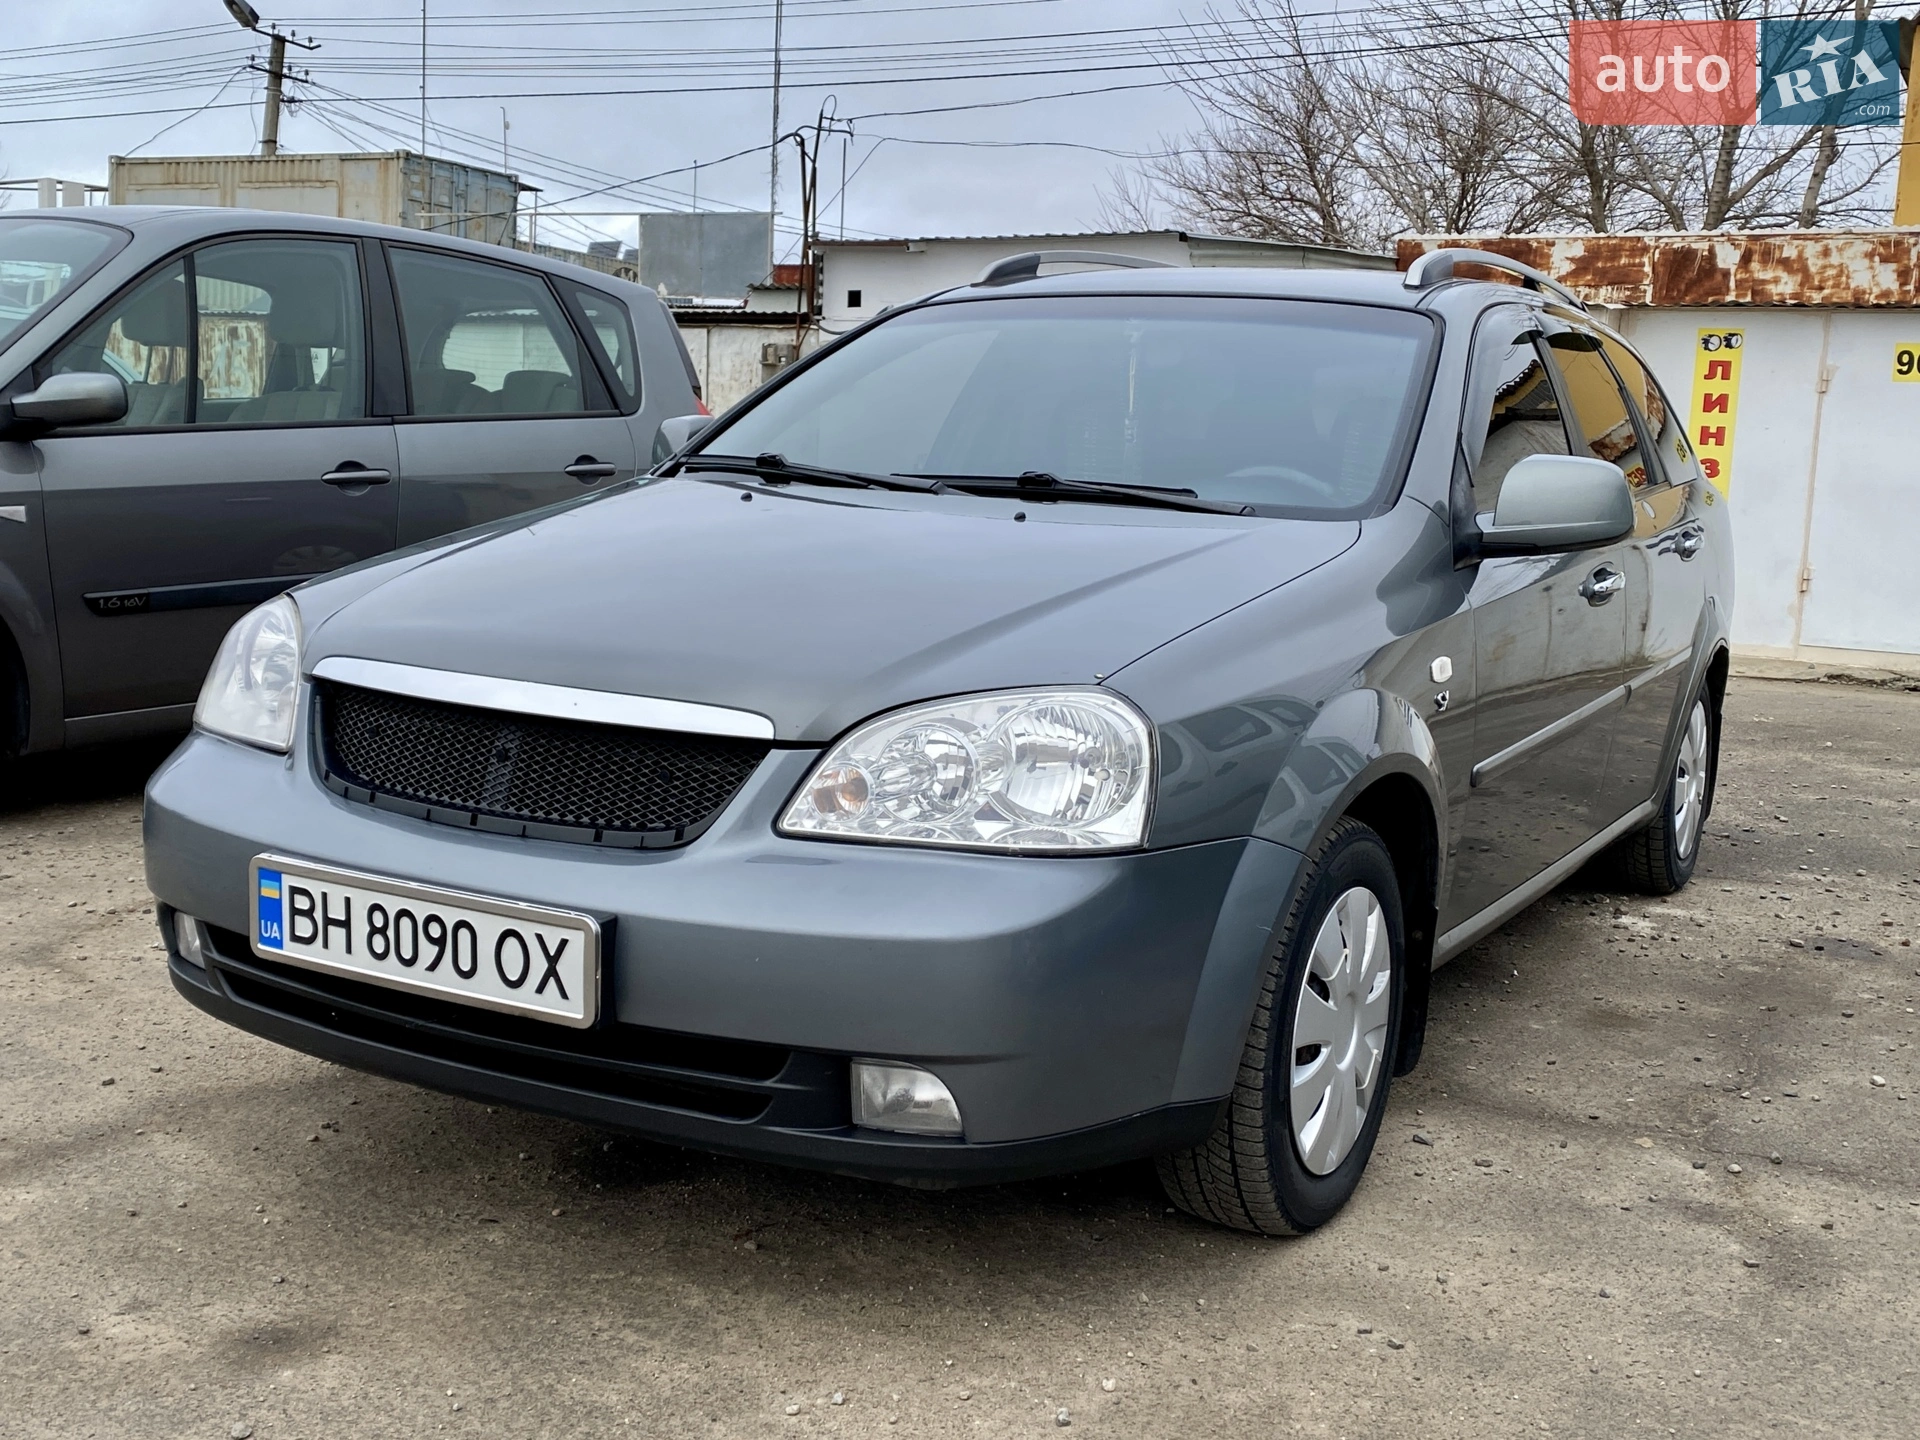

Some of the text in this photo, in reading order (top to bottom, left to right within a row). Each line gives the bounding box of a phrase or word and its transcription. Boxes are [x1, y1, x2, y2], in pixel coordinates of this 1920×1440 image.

[1897, 350, 1920, 375] 9
[1700, 360, 1732, 480] ЛИНЗ
[99, 596, 146, 609] 1.6 16V
[261, 920, 280, 940] UA
[288, 885, 570, 1000] BH 8090 OX
